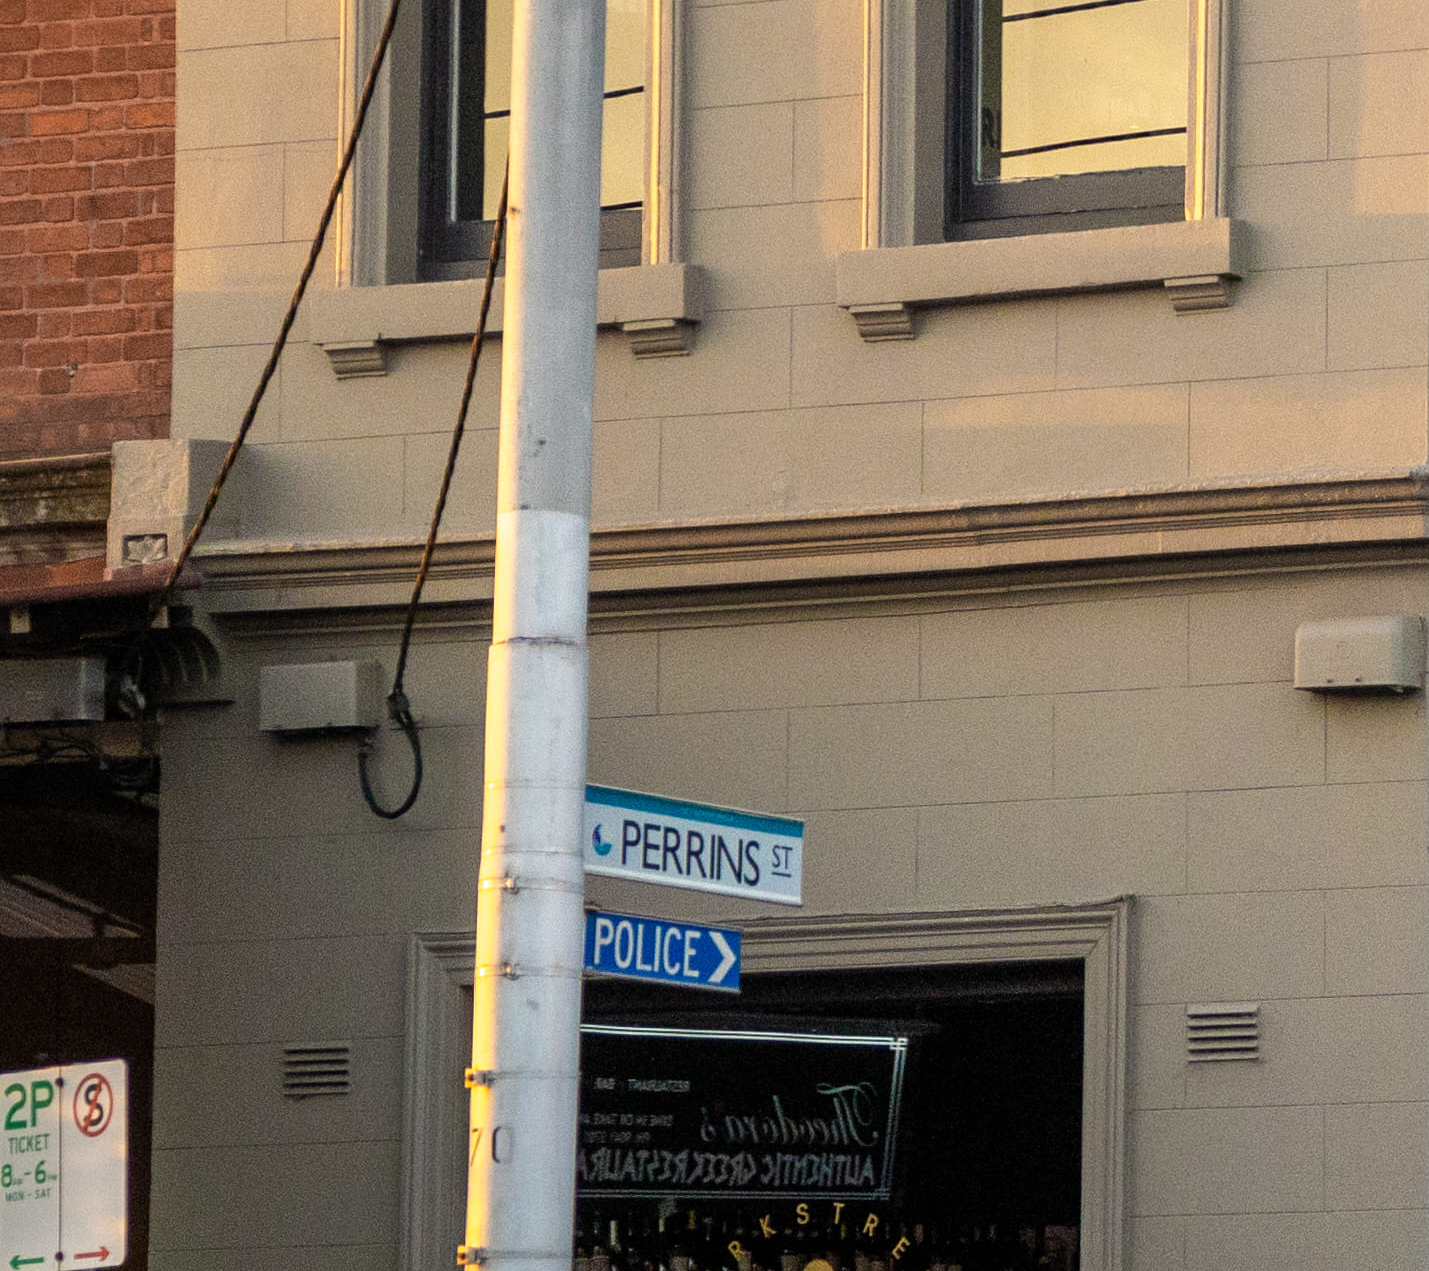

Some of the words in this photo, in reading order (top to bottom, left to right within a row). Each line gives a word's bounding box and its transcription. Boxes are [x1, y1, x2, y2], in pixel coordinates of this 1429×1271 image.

[621, 820, 760, 886] PERRINS
[771, 845, 793, 877] ST
[594, 917, 701, 978] POLICE
[4, 1079, 55, 1131] 2P
[8, 1133, 51, 1155] TICKET
[5, 1190, 25, 1202] MON
[34, 1187, 52, 1200] SAT
